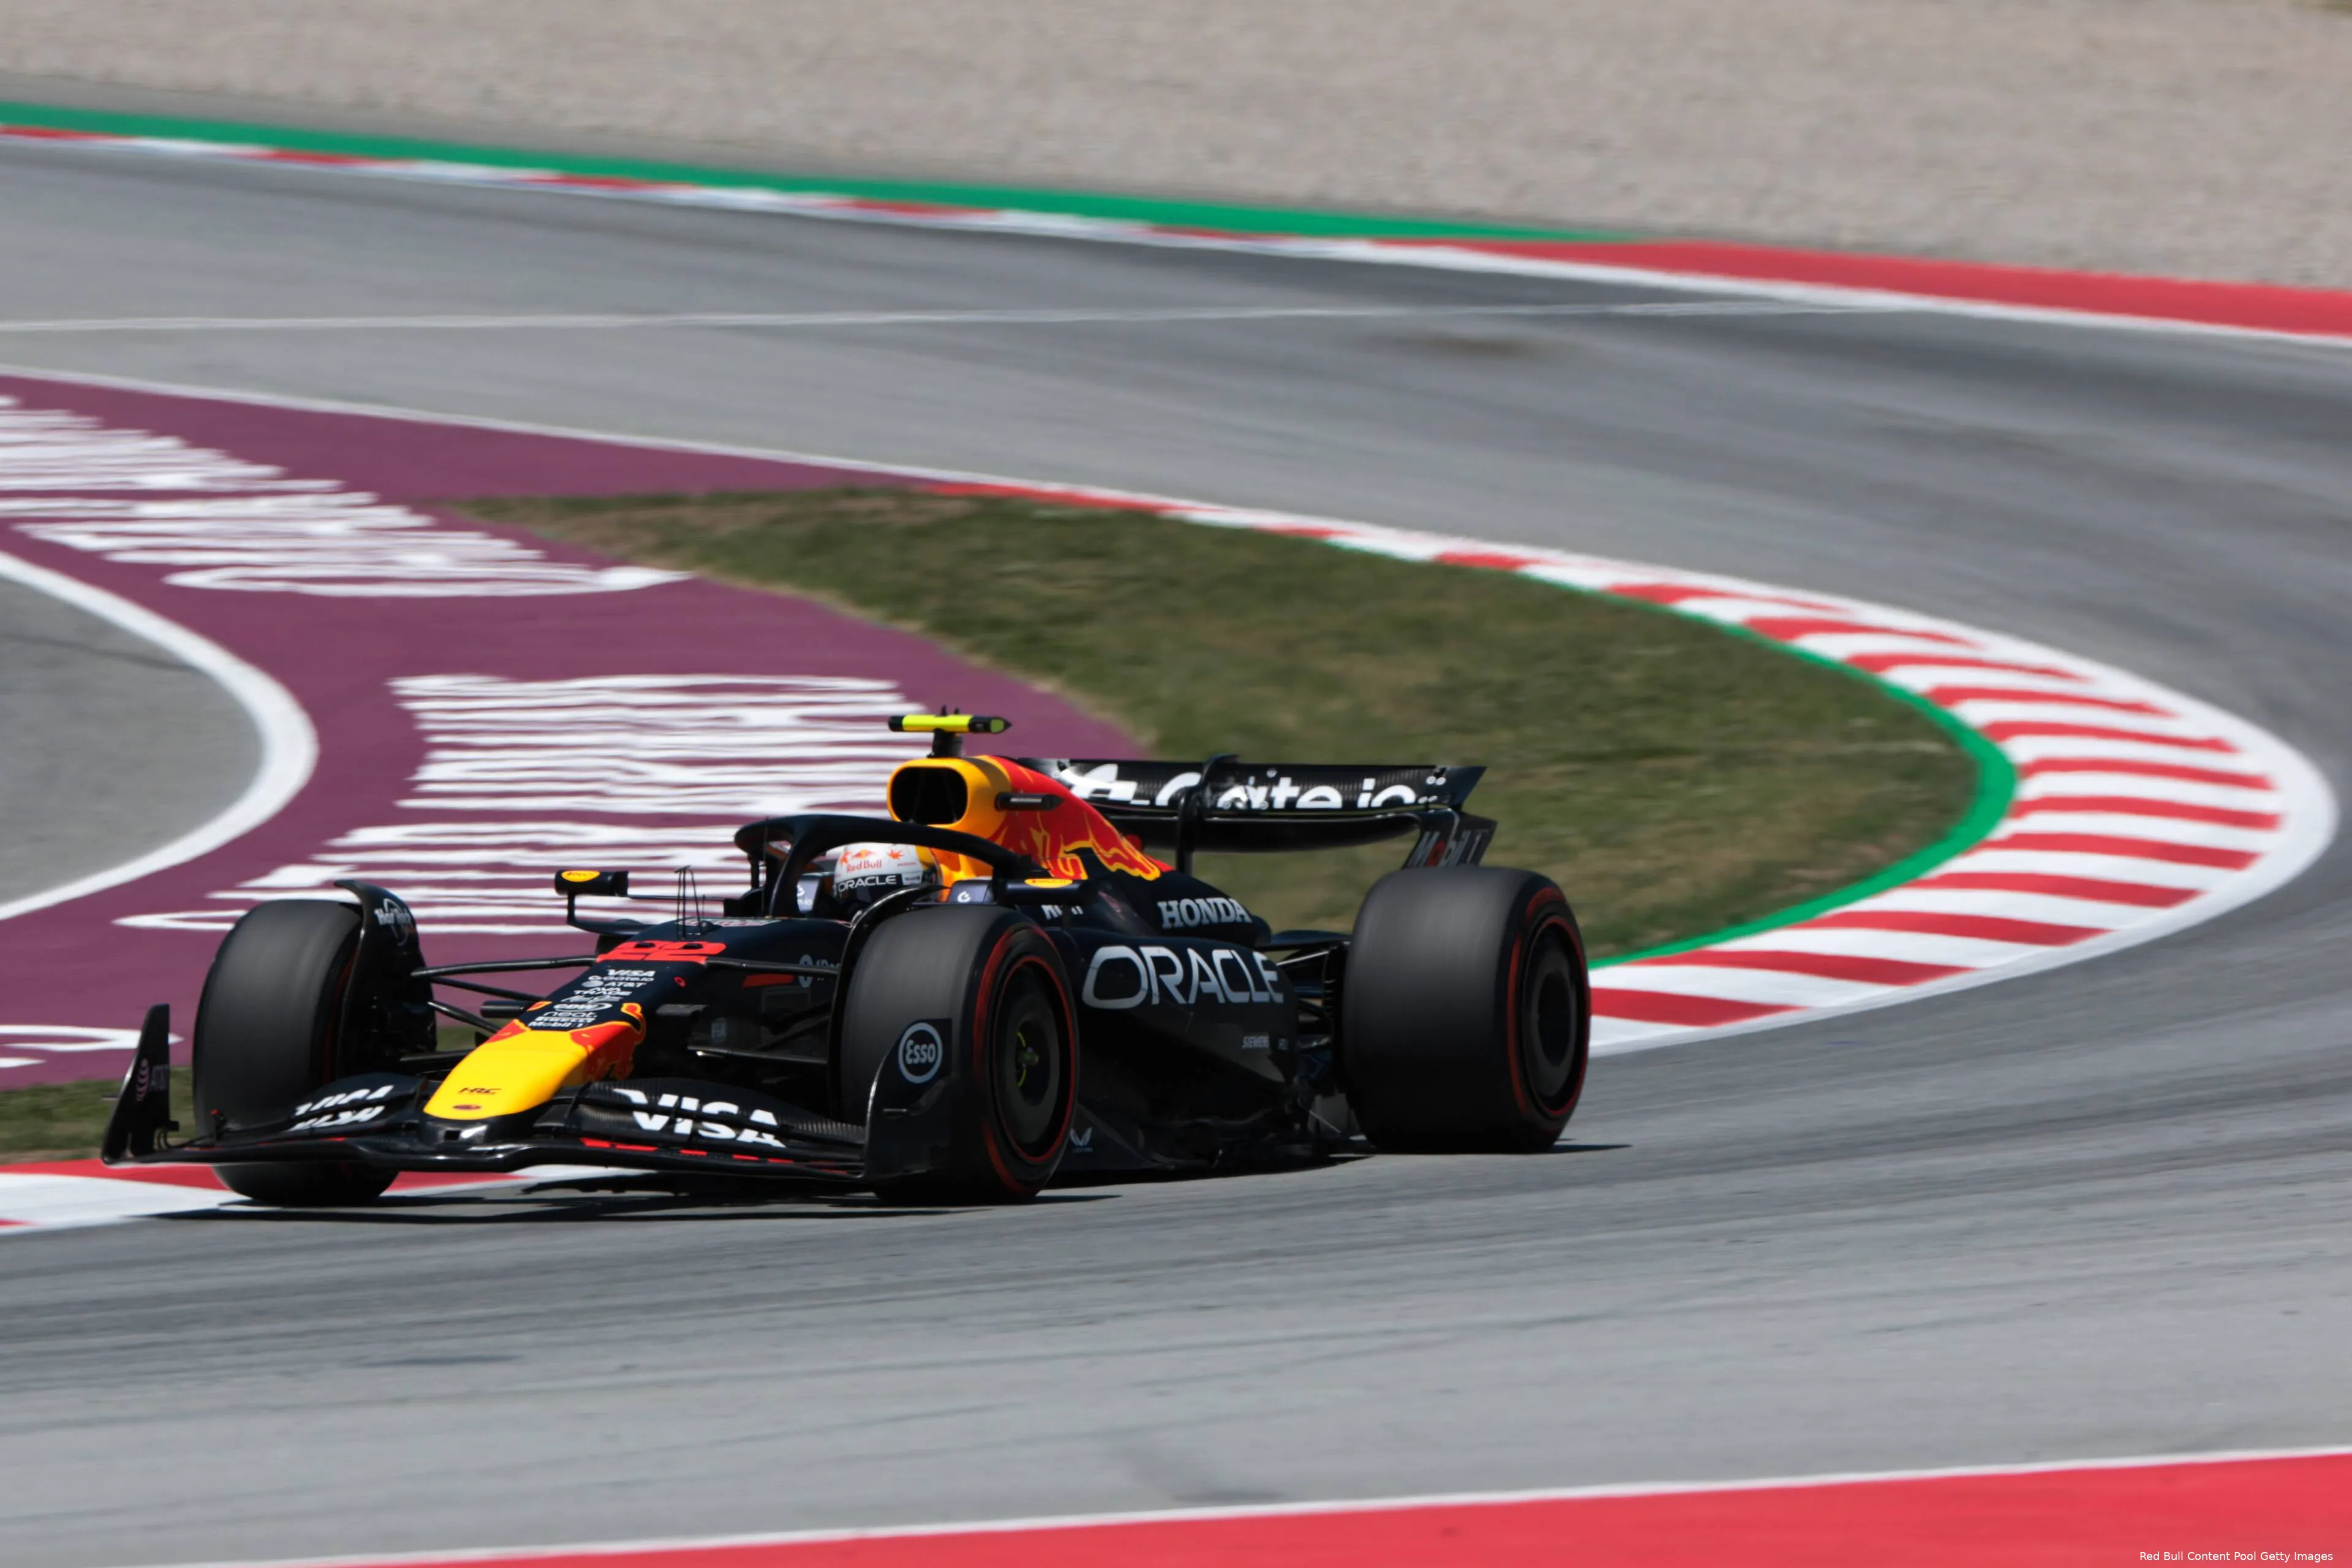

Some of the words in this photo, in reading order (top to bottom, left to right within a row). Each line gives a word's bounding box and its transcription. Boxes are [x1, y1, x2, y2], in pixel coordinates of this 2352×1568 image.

[845, 860, 863, 873] Red
[863, 859, 882, 869] Bull
[838, 875, 898, 893] ORACLE
[1157, 897, 1253, 929] HONDA
[1082, 945, 1284, 1009] ORACLE
[906, 1039, 936, 1065] Esso
[613, 1088, 787, 1148] VISA
